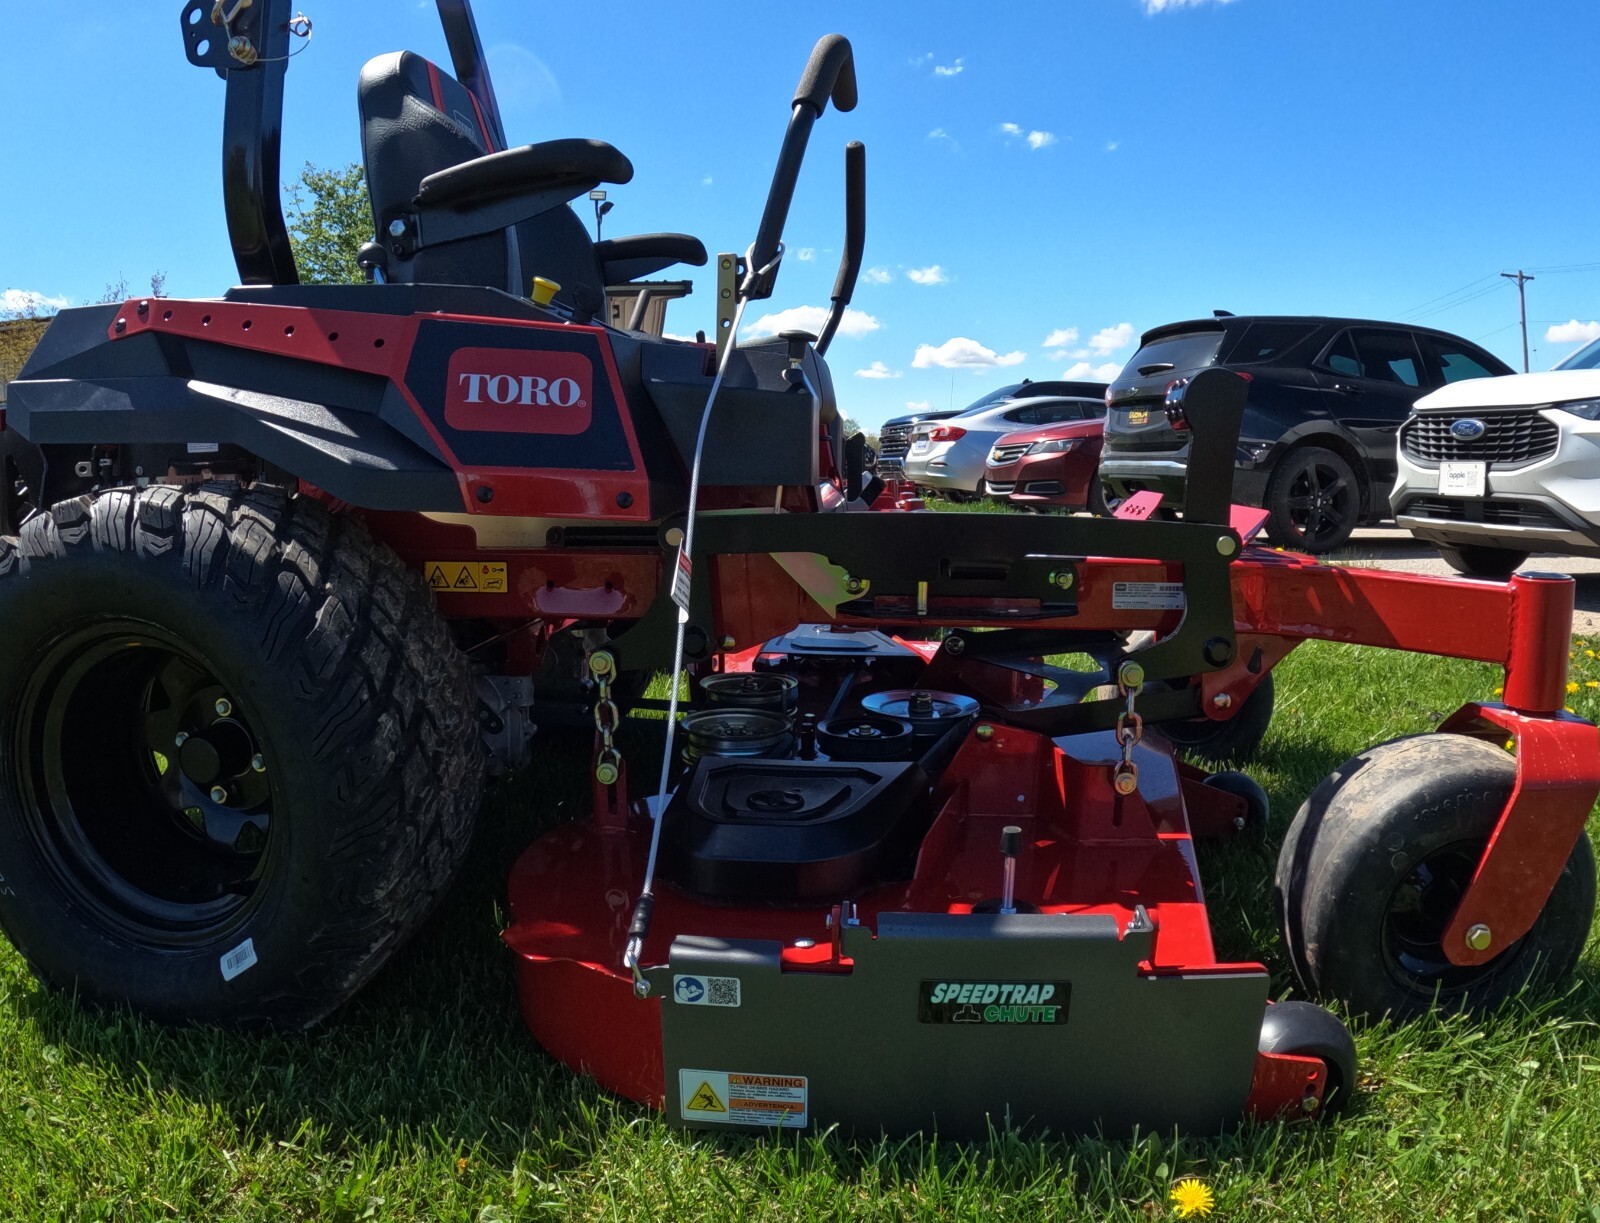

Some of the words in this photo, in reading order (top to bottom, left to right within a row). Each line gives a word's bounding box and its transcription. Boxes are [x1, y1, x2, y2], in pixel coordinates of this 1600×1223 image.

[459, 373, 581, 407] TORO
[1456, 423, 1476, 435] Ford
[931, 983, 1055, 1004] SPEEDTRAP
[984, 1005, 1057, 1022] CHUTE
[744, 1077, 802, 1087] WARNING
